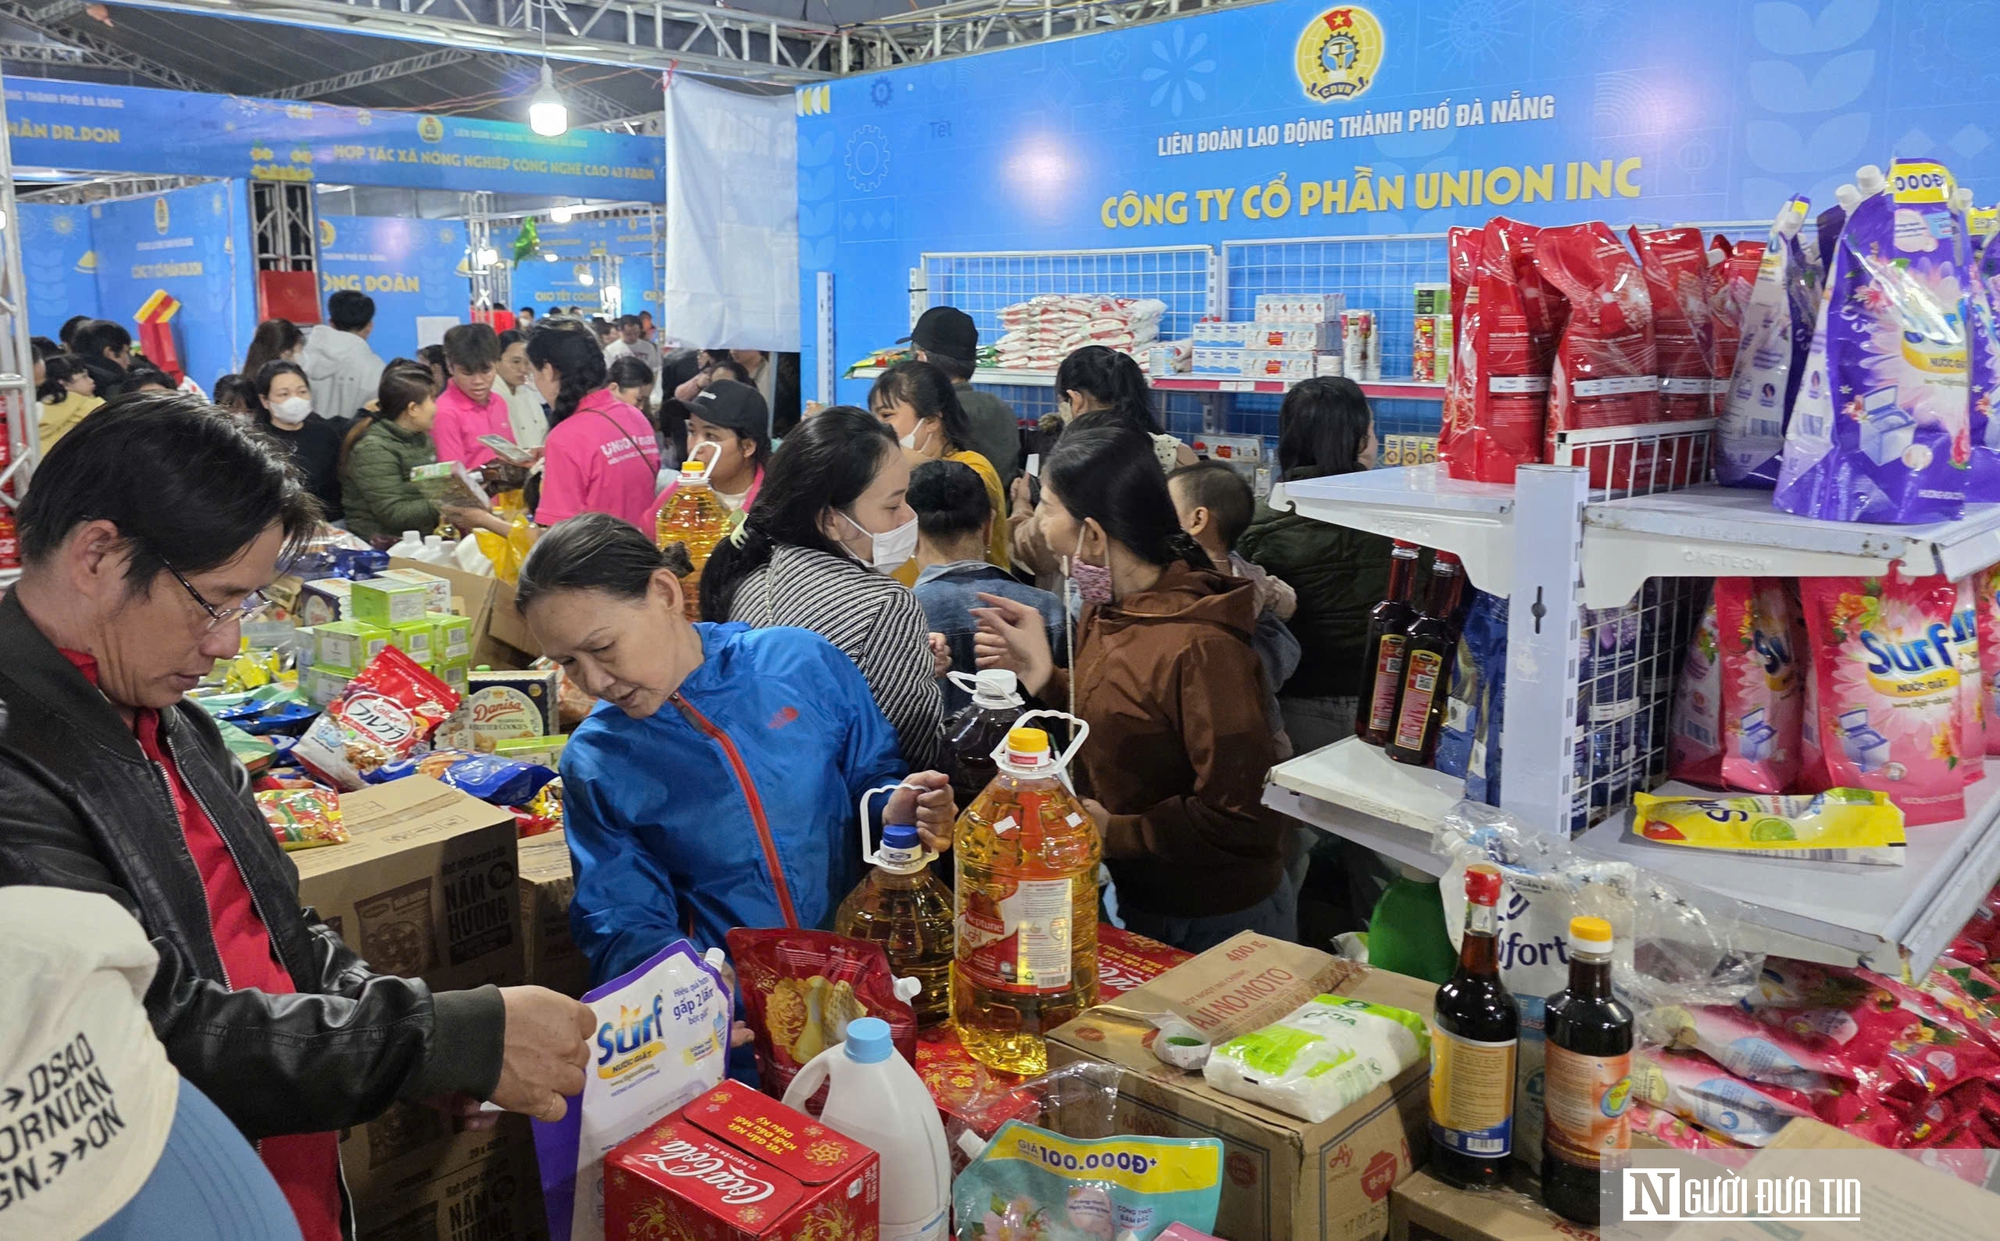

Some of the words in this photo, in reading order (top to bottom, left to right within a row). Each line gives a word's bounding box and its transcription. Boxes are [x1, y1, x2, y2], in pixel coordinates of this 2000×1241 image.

[1157, 132, 1194, 157] LIÊN
[1197, 126, 1244, 153] ĐOÀN
[1247, 125, 1279, 148] LAO
[1283, 117, 1334, 147] ĐỘNG
[1339, 110, 1403, 138] THÀNH
[1408, 97, 1451, 131] PHỐ
[1455, 101, 1485, 127] ĐÀ
[1491, 90, 1556, 123] NẴNG
[368, 145, 395, 162] TÁC
[397, 147, 418, 163] XÃ
[421, 151, 462, 168] NÔNG
[464, 154, 511, 171] NGHIỆP
[512, 157, 547, 173] CÔNG
[584, 165, 610, 178] CAO
[624, 167, 656, 181] FARM
[1101, 190, 1188, 228] CÔNG
[1195, 187, 1236, 222] TY
[1241, 171, 1292, 220] CỔ
[1299, 165, 1405, 216] PHẦN
[1415, 163, 1555, 210] UNION
[1565, 156, 1642, 201] INC
[365, 273, 419, 293] ĐOÀN
[1859, 622, 1954, 674] Surf
[473, 699, 524, 722] Danisa
[966, 911, 1004, 932] Neptune
[1225, 943, 1258, 965] 400
[1255, 939, 1269, 952] g
[1497, 932, 1570, 971] fort
[673, 984, 690, 1000] Hiệu
[672, 995, 697, 1021] gấp
[695, 993, 704, 1009] 2
[597, 994, 664, 1067] Surf
[612, 1057, 634, 1073] NƯỚC
[632, 1050, 654, 1067] GIẶT
[86, 1099, 126, 1150] ON
[727, 1121, 747, 1137] Kết
[733, 1115, 754, 1130] Mới
[752, 1123, 774, 1140] Đầu
[754, 1115, 771, 1128] Kỳ
[770, 1121, 794, 1140] Diệu
[746, 1130, 767, 1145] Gắn
[764, 1140, 786, 1157] Tết
[1017, 1138, 1039, 1155] GIÁ
